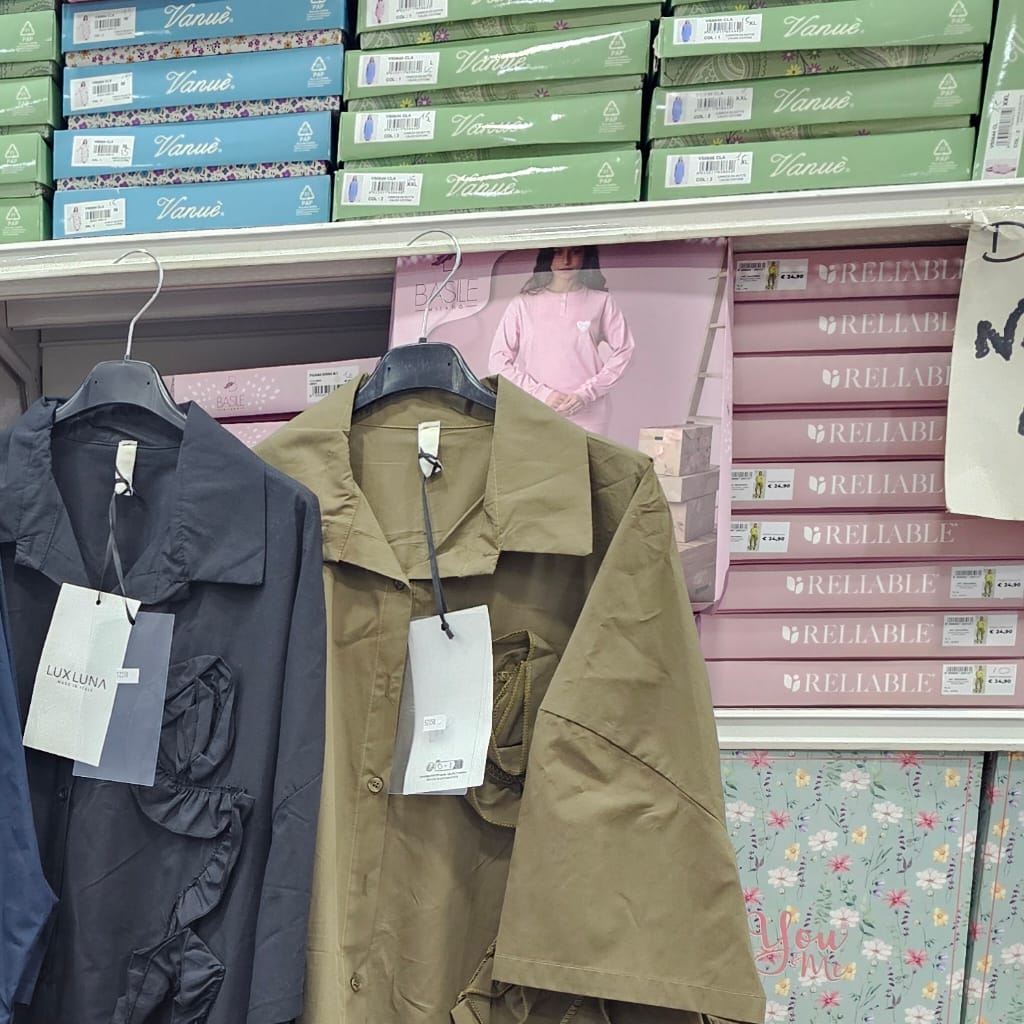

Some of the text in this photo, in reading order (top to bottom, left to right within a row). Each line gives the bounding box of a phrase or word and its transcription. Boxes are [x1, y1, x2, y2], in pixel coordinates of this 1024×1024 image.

[163, 3, 232, 29] Vanuè
[783, 15, 863, 38] Vanuè
[165, 70, 234, 95] Vanuè
[773, 88, 852, 114] Vanuè
[153, 134, 221, 158] Vanuè
[769, 152, 849, 178] Vanuè
[156, 196, 223, 220] Vanuè
[415, 278, 479, 307] BASILE
[840, 311, 955, 336] RELIABL
[216, 394, 245, 408] BASILE
[829, 420, 944, 444] RELIABL
[831, 473, 944, 496] RELIABL
[825, 523, 956, 546] RELIABLE
[807, 573, 937, 595] RELIABLE
[803, 623, 932, 645] RELIABLE
[804, 672, 932, 694] RELIABLE
[747, 911, 848, 976] You
[800, 951, 849, 981] Me
